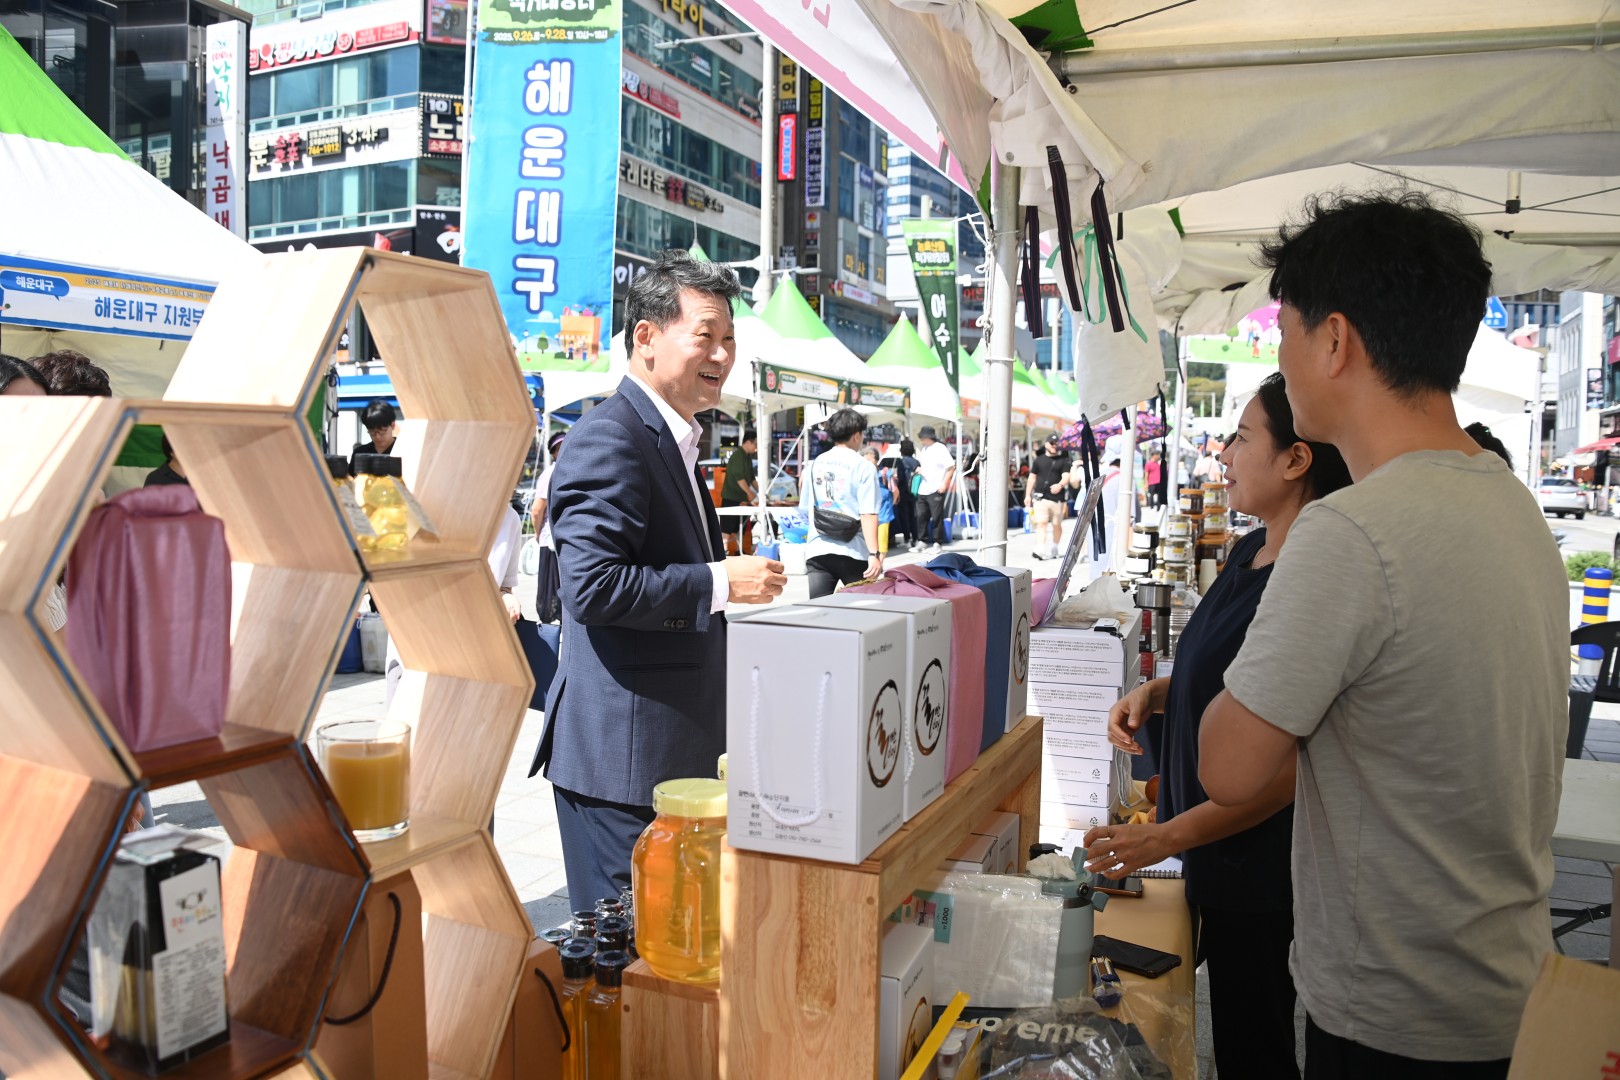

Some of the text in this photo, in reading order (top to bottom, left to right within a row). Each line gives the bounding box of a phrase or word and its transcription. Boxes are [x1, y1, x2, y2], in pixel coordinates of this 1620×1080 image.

[428, 99, 448, 112] 10
[513, 59, 574, 313] 해운대구
[15, 275, 55, 291] 해운대구
[94, 296, 158, 324] 해운대구
[970, 1016, 1099, 1044] preme
